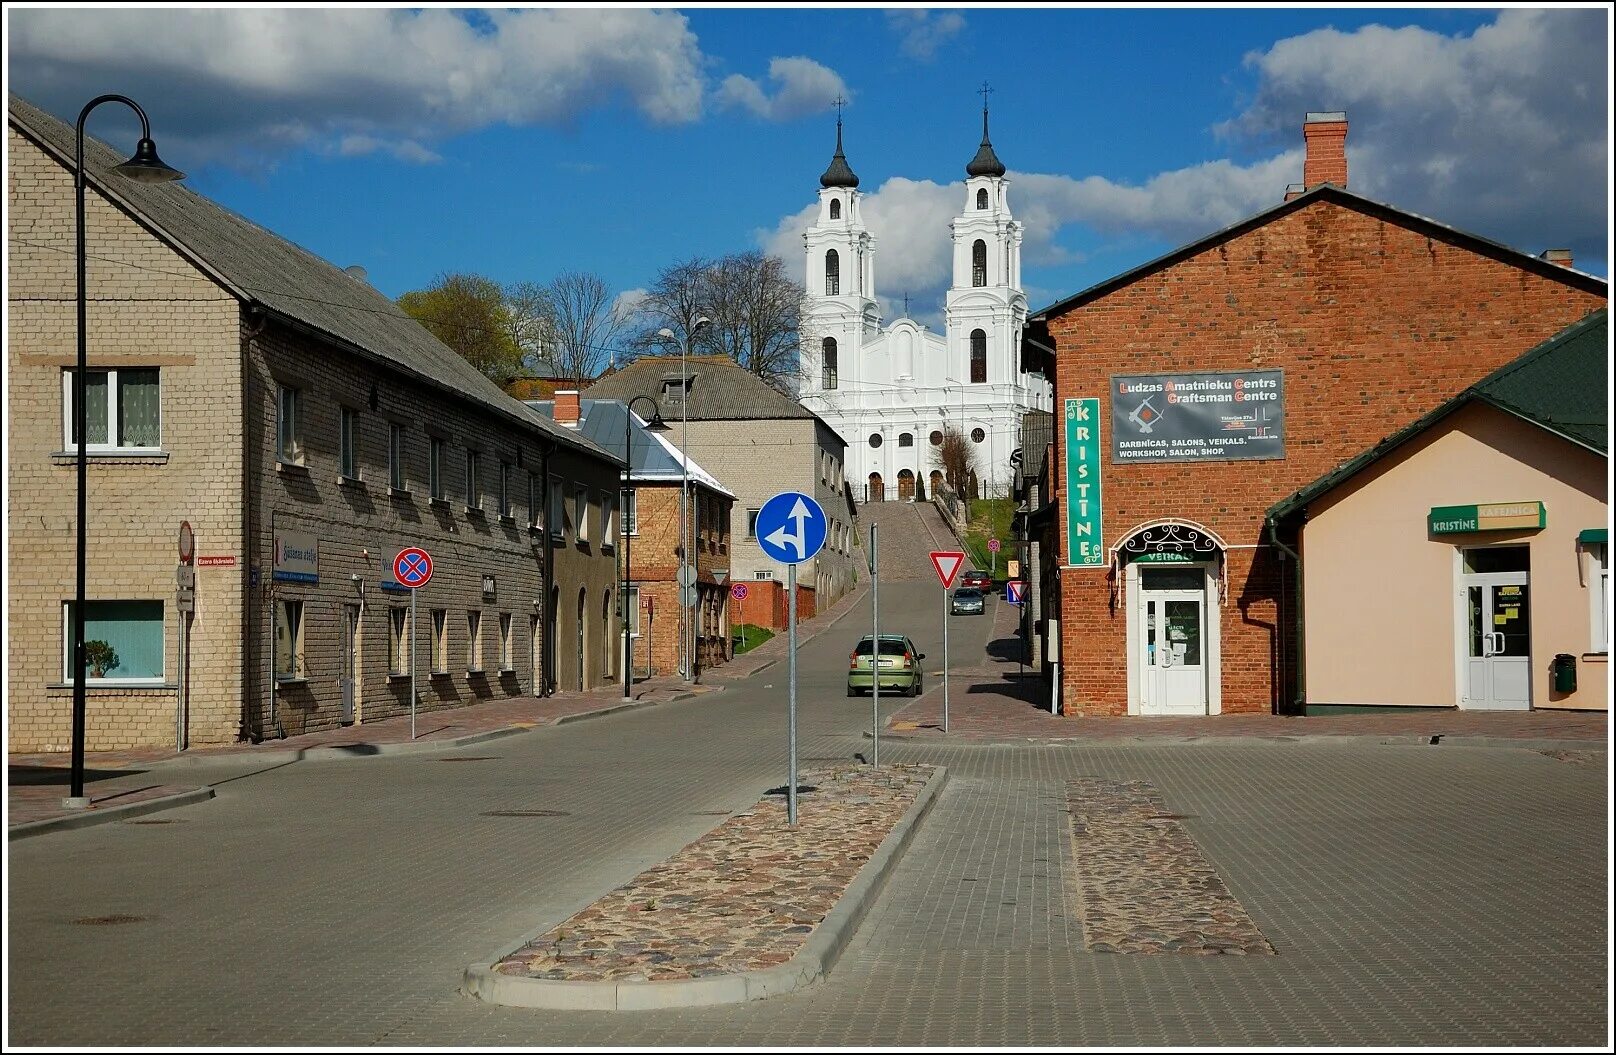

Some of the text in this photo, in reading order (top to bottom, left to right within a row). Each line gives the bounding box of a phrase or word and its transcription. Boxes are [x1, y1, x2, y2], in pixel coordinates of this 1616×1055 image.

[1119, 378, 1277, 394] Ludzas Amatnieku Centrs
[1167, 391, 1278, 404] Craftsman Centre
[1119, 437, 1248, 449] DARBNĪCAS, SALONS, VEIKALS.
[1119, 447, 1225, 458] WORKSHOP, SALON, SHOP.
[1076, 406, 1092, 556] KRISTĪNE
[1433, 518, 1476, 532] KRISTĪNE
[1148, 552, 1194, 561] VEIKALS
